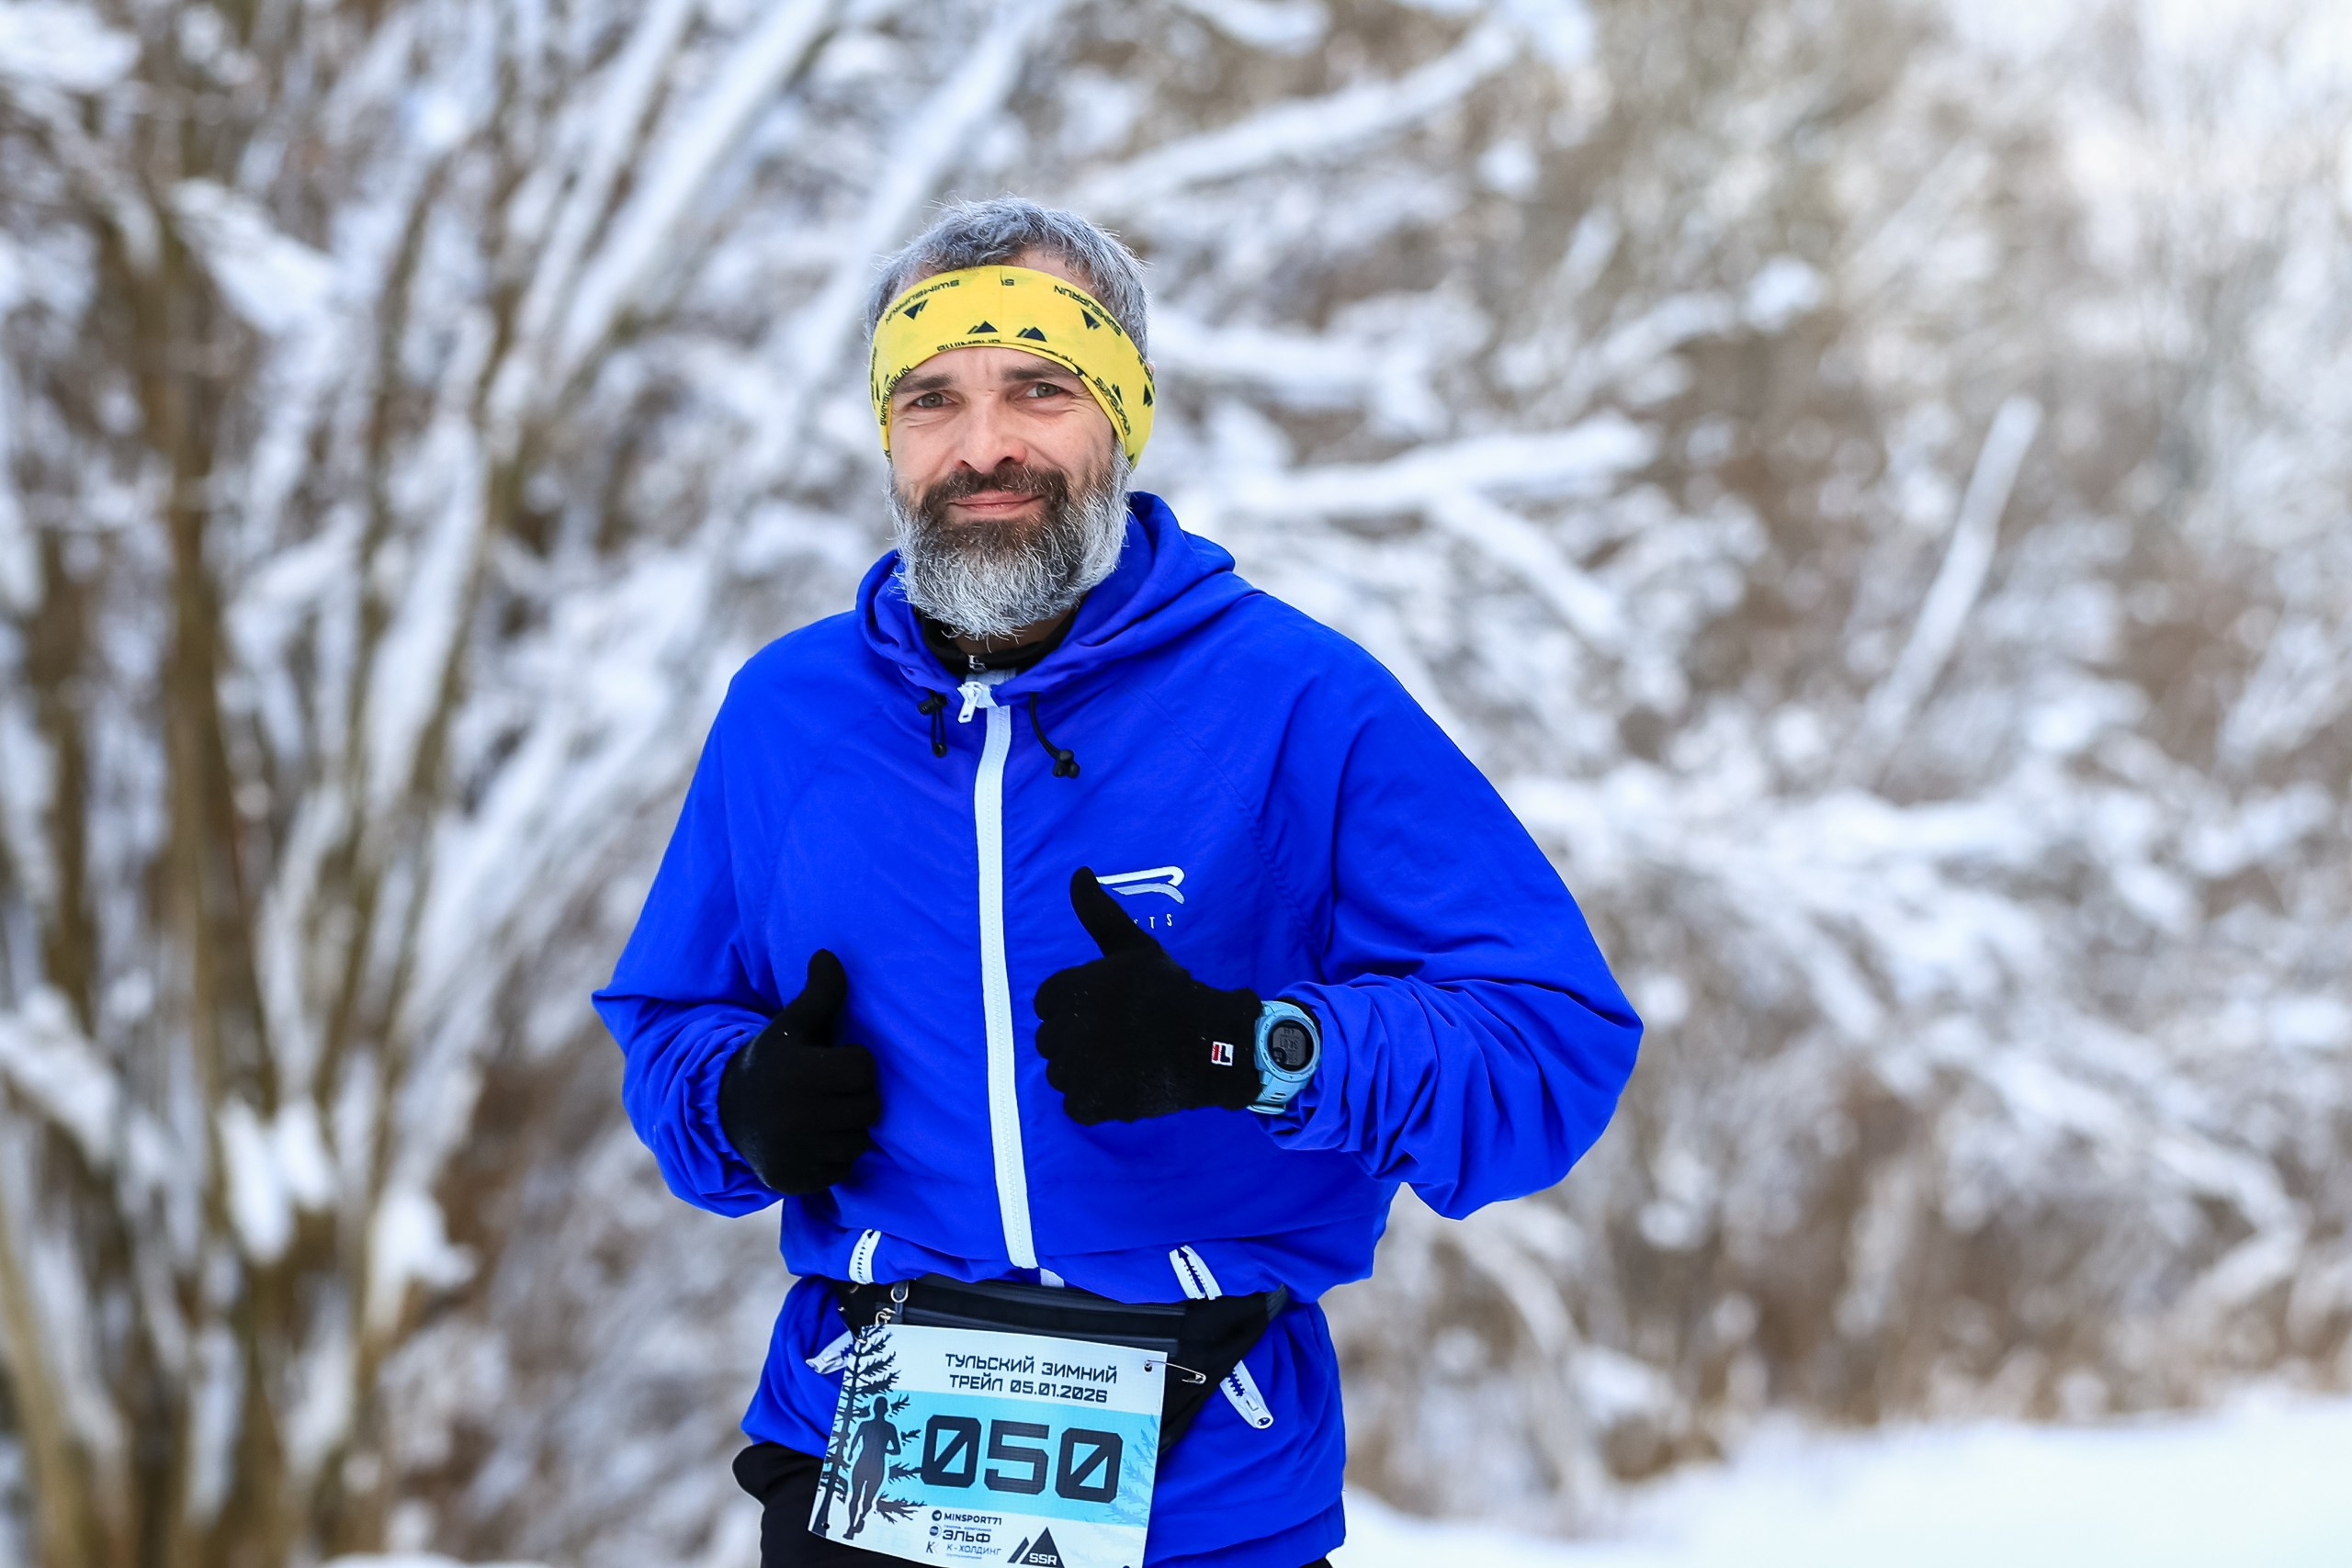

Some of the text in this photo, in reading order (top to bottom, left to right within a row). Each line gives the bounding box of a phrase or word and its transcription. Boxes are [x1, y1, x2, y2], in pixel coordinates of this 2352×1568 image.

[944, 1353, 1118, 1384] ТУЛЬСКИЙ ЗИМНИЙ
[949, 1373, 1108, 1404] ТРЕЙЛ 05.01.2026
[920, 1414, 1124, 1504] 050
[944, 1512, 1002, 1526] MINSPORT71
[943, 1529, 990, 1542] ЭЛЬФ
[1028, 1552, 1057, 1565] SSR
